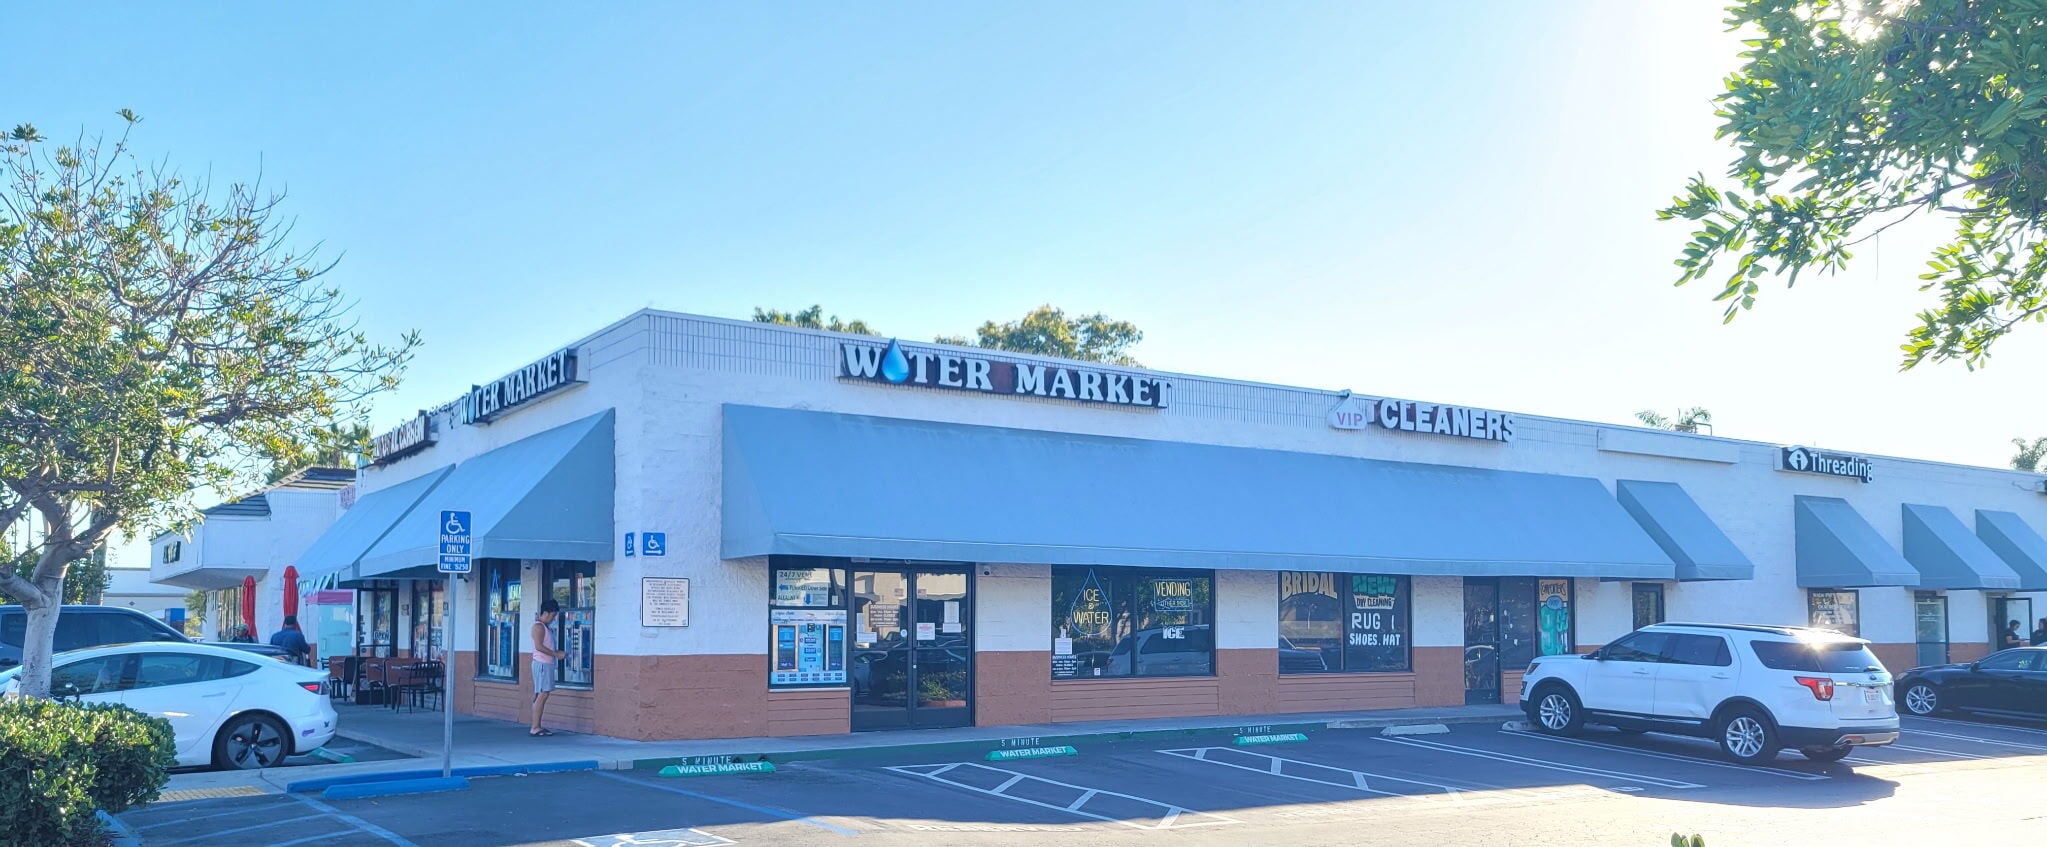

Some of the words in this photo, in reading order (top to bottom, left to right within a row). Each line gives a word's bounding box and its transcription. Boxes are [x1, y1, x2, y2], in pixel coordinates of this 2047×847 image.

[503, 349, 568, 405] MARKET
[1015, 362, 1172, 408] MARKET
[1337, 411, 1363, 427] VIP
[1380, 399, 1515, 443] CLEANERS
[1810, 452, 1873, 483] Threading
[441, 534, 470, 545] PARKING
[446, 544, 465, 554] ONLY
[1155, 581, 1191, 597] VENDING
[1281, 571, 1338, 601] BRIDAL
[1352, 574, 1397, 595] NEW
[1083, 588, 1099, 603] ICE
[1073, 611, 1109, 625] WATER
[1351, 612, 1381, 630] RUG
[1162, 625, 1185, 640] ICE
[1382, 634, 1401, 646] HAT
[1001, 739, 1006, 747] 5
[1011, 737, 1040, 747] MINUTE
[1000, 748, 1031, 758] WATER
[1030, 746, 1067, 756] MARKET
[676, 763, 717, 774] WATER
[718, 762, 764, 773] MARKET
[682, 757, 688, 766] 5
[695, 755, 732, 766] MINUTE
